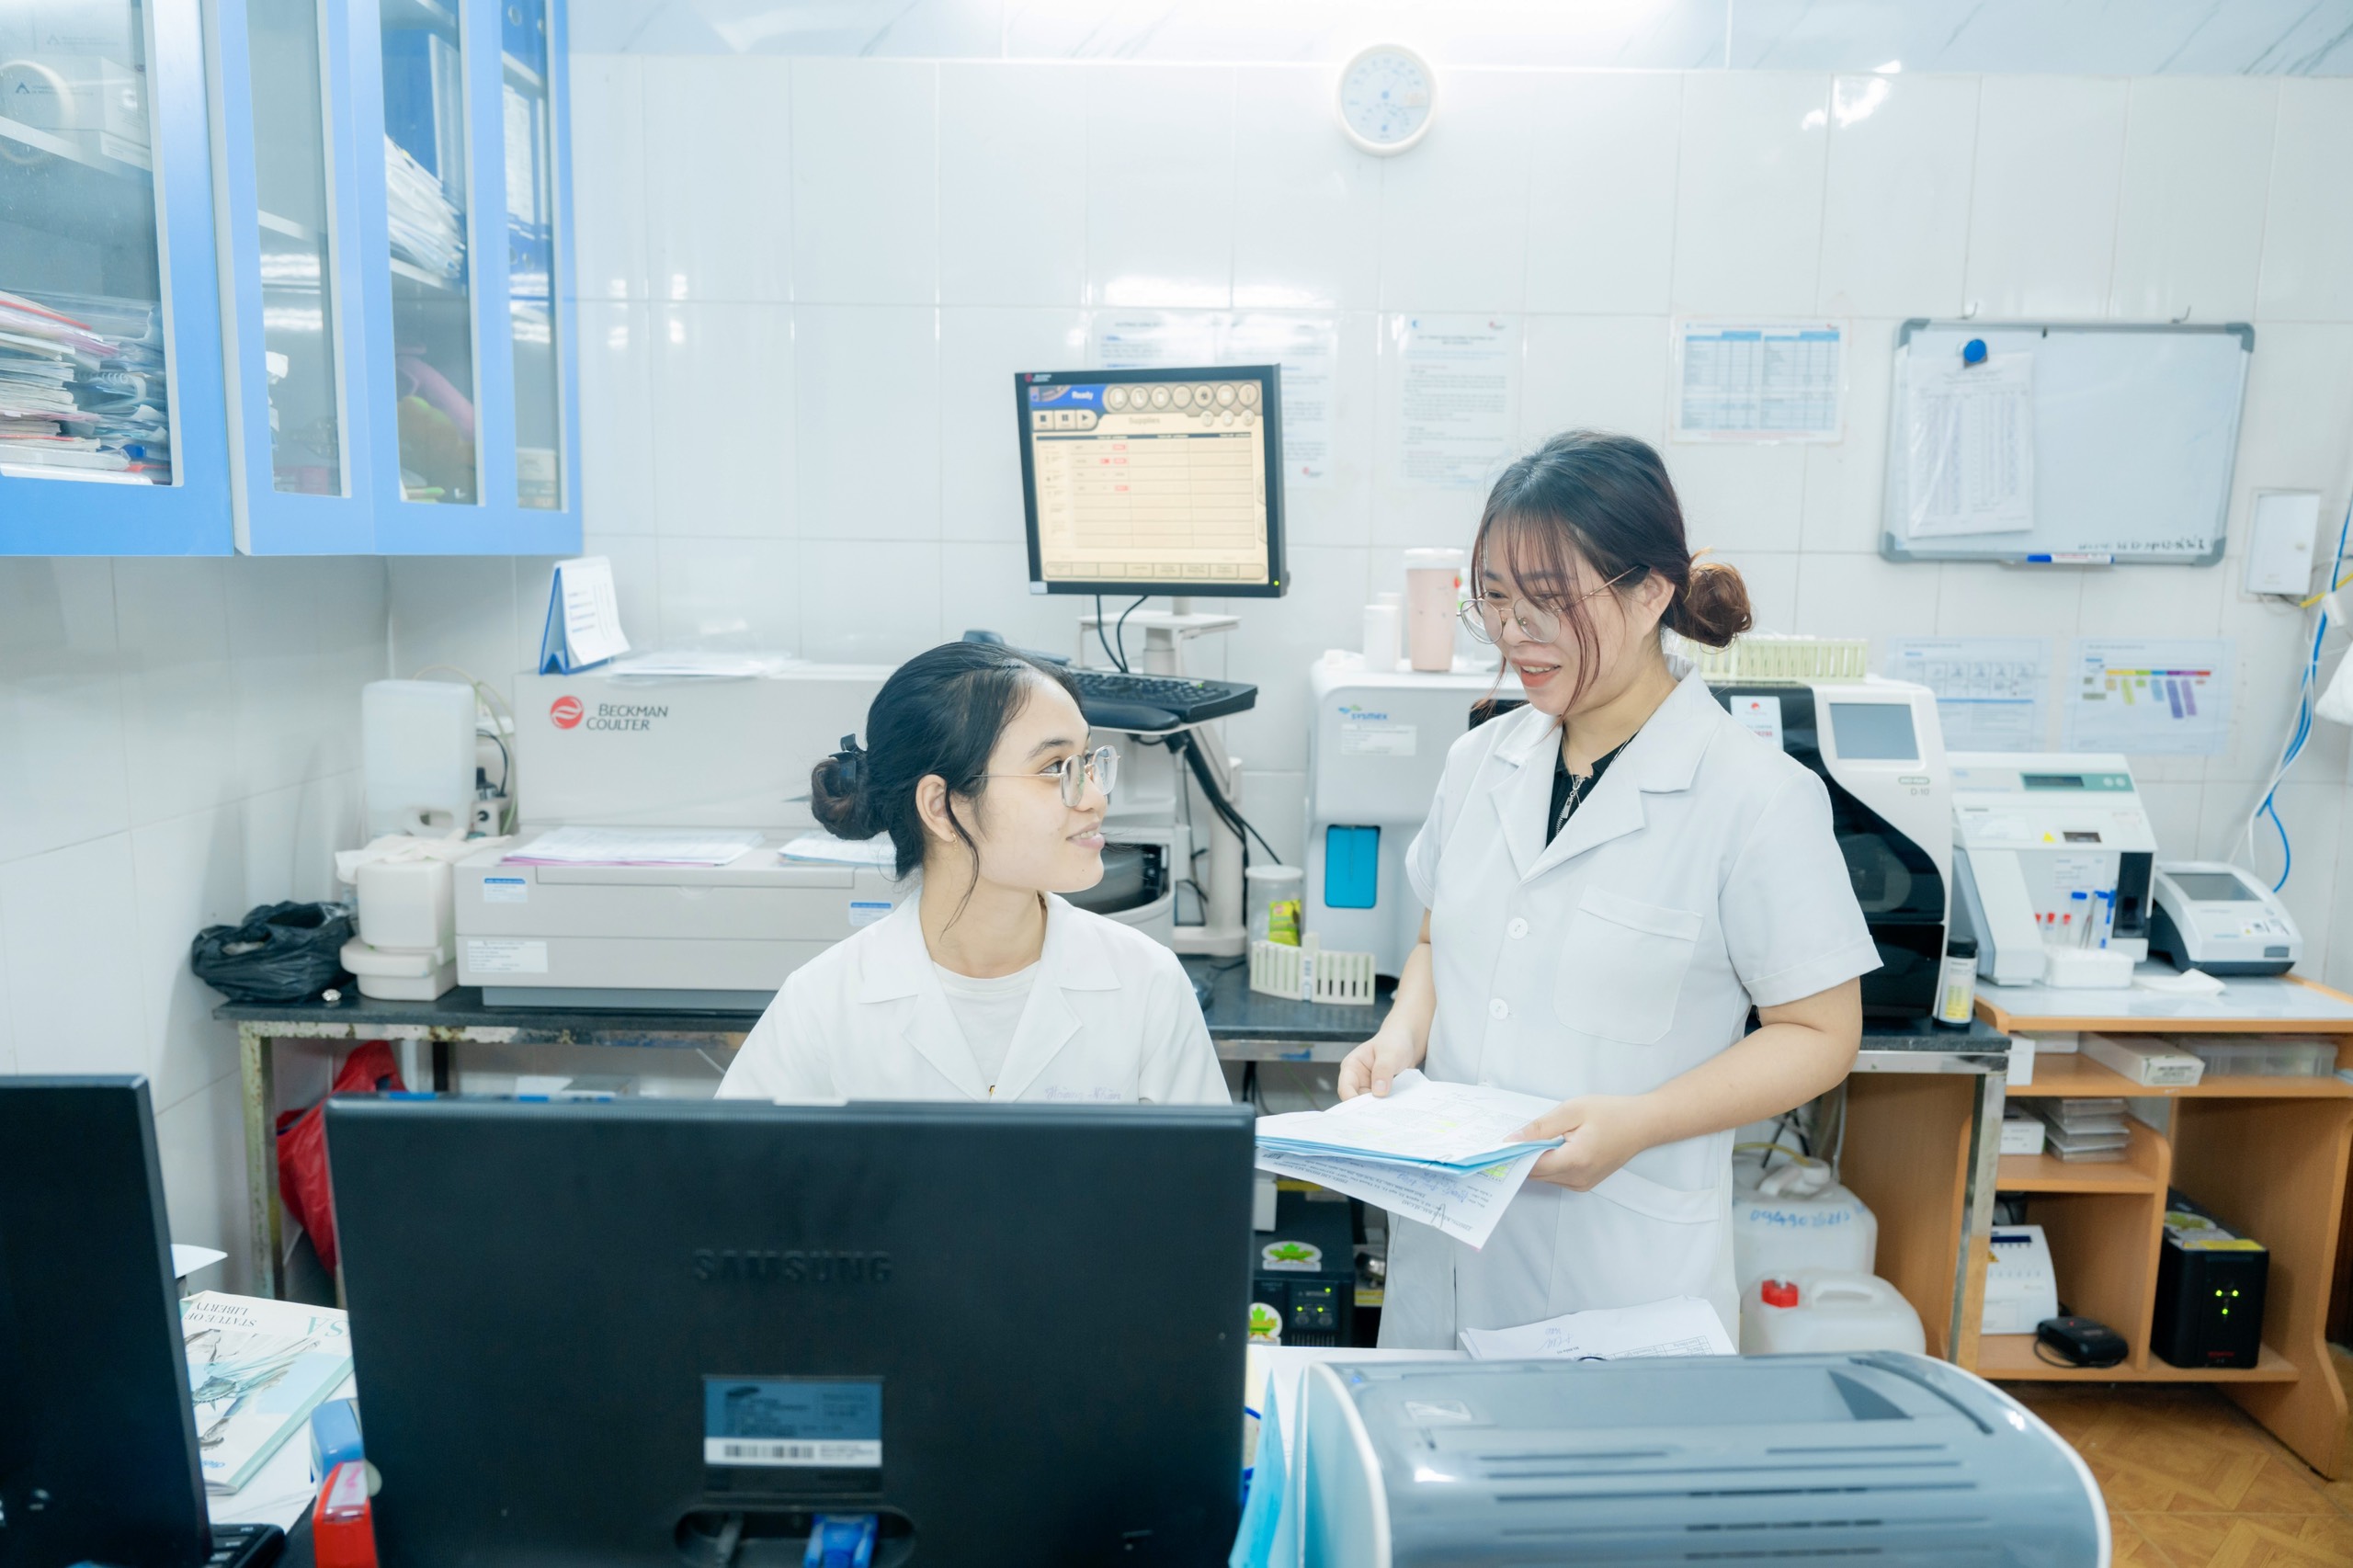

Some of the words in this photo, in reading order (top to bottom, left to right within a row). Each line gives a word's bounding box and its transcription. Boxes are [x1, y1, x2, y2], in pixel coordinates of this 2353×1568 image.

[1071, 391, 1094, 401] Ready
[1129, 416, 1160, 426] Supplies
[598, 703, 668, 717] BECKMAN
[1351, 712, 1388, 721] sysmex
[586, 717, 651, 731] COULTER
[1910, 788, 1930, 796] D-10
[694, 1248, 892, 1282] SAMSUNG
[193, 1301, 248, 1315] LIBERTY
[186, 1312, 205, 1321] OF
[206, 1315, 256, 1328] STATUE
[306, 1316, 348, 1338] SA
